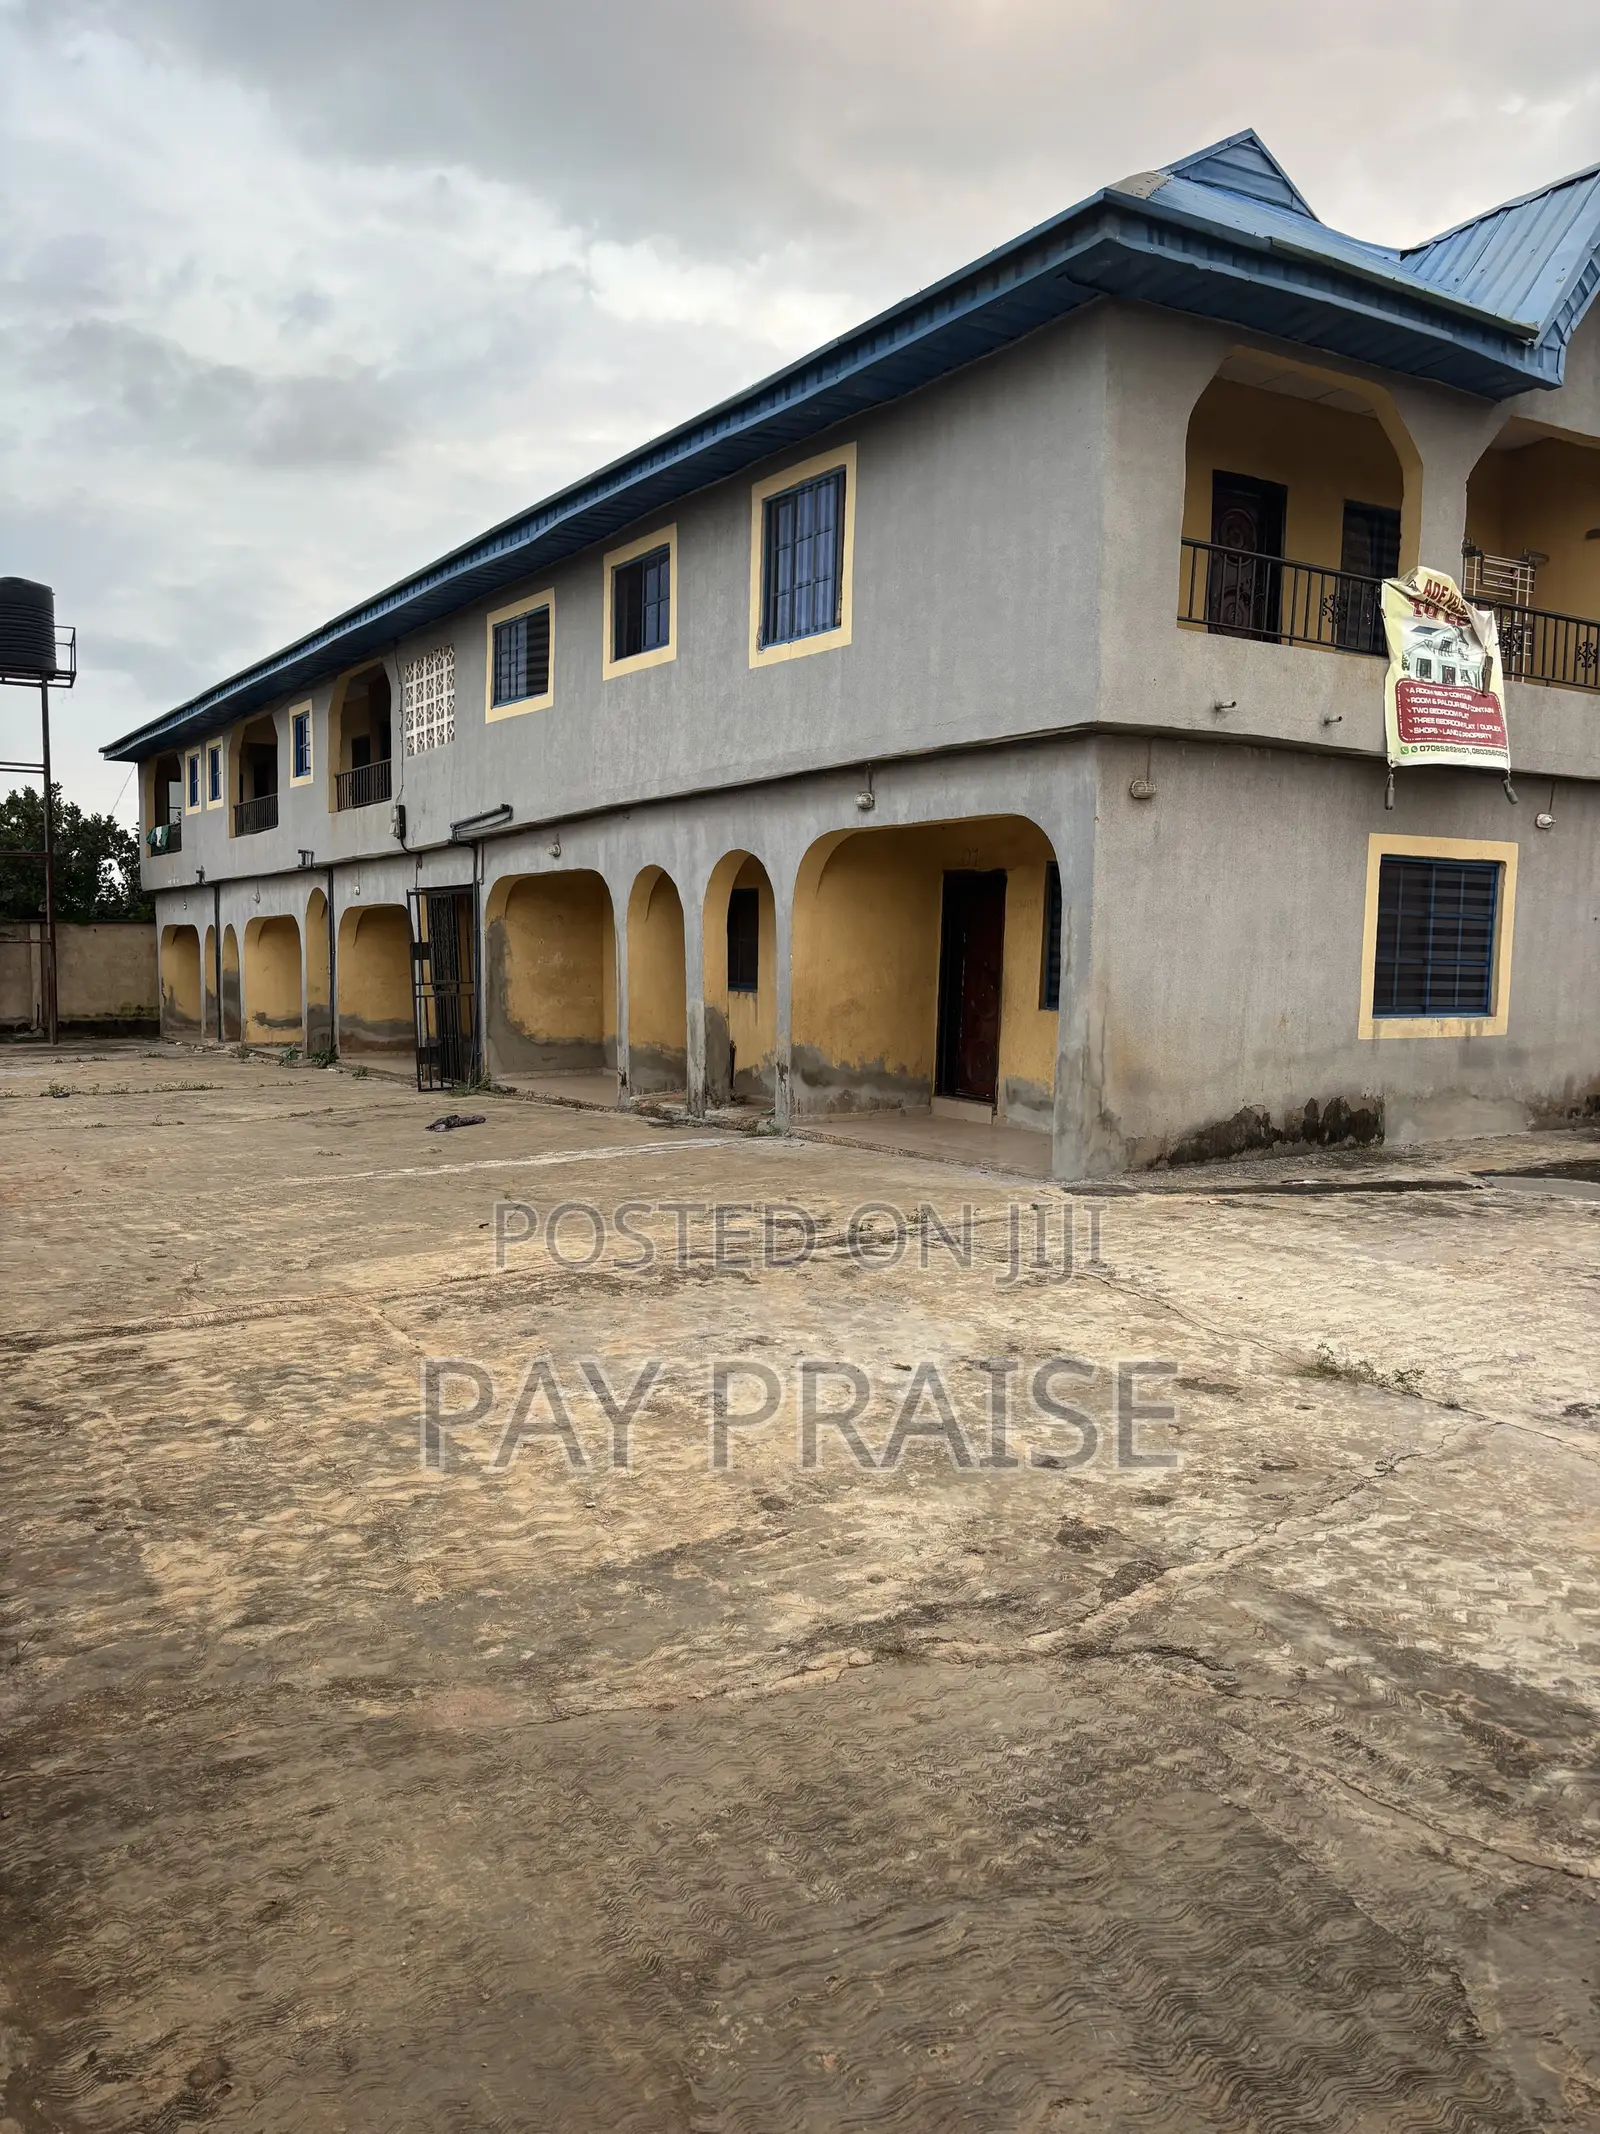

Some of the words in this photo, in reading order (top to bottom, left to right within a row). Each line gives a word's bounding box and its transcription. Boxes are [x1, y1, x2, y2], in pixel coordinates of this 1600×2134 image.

[1429, 708, 1458, 717] BEDROOM
[1436, 718, 1464, 727] BEDROOM
[1480, 724, 1502, 732] DUPLEX
[1443, 728, 1458, 736] LAND
